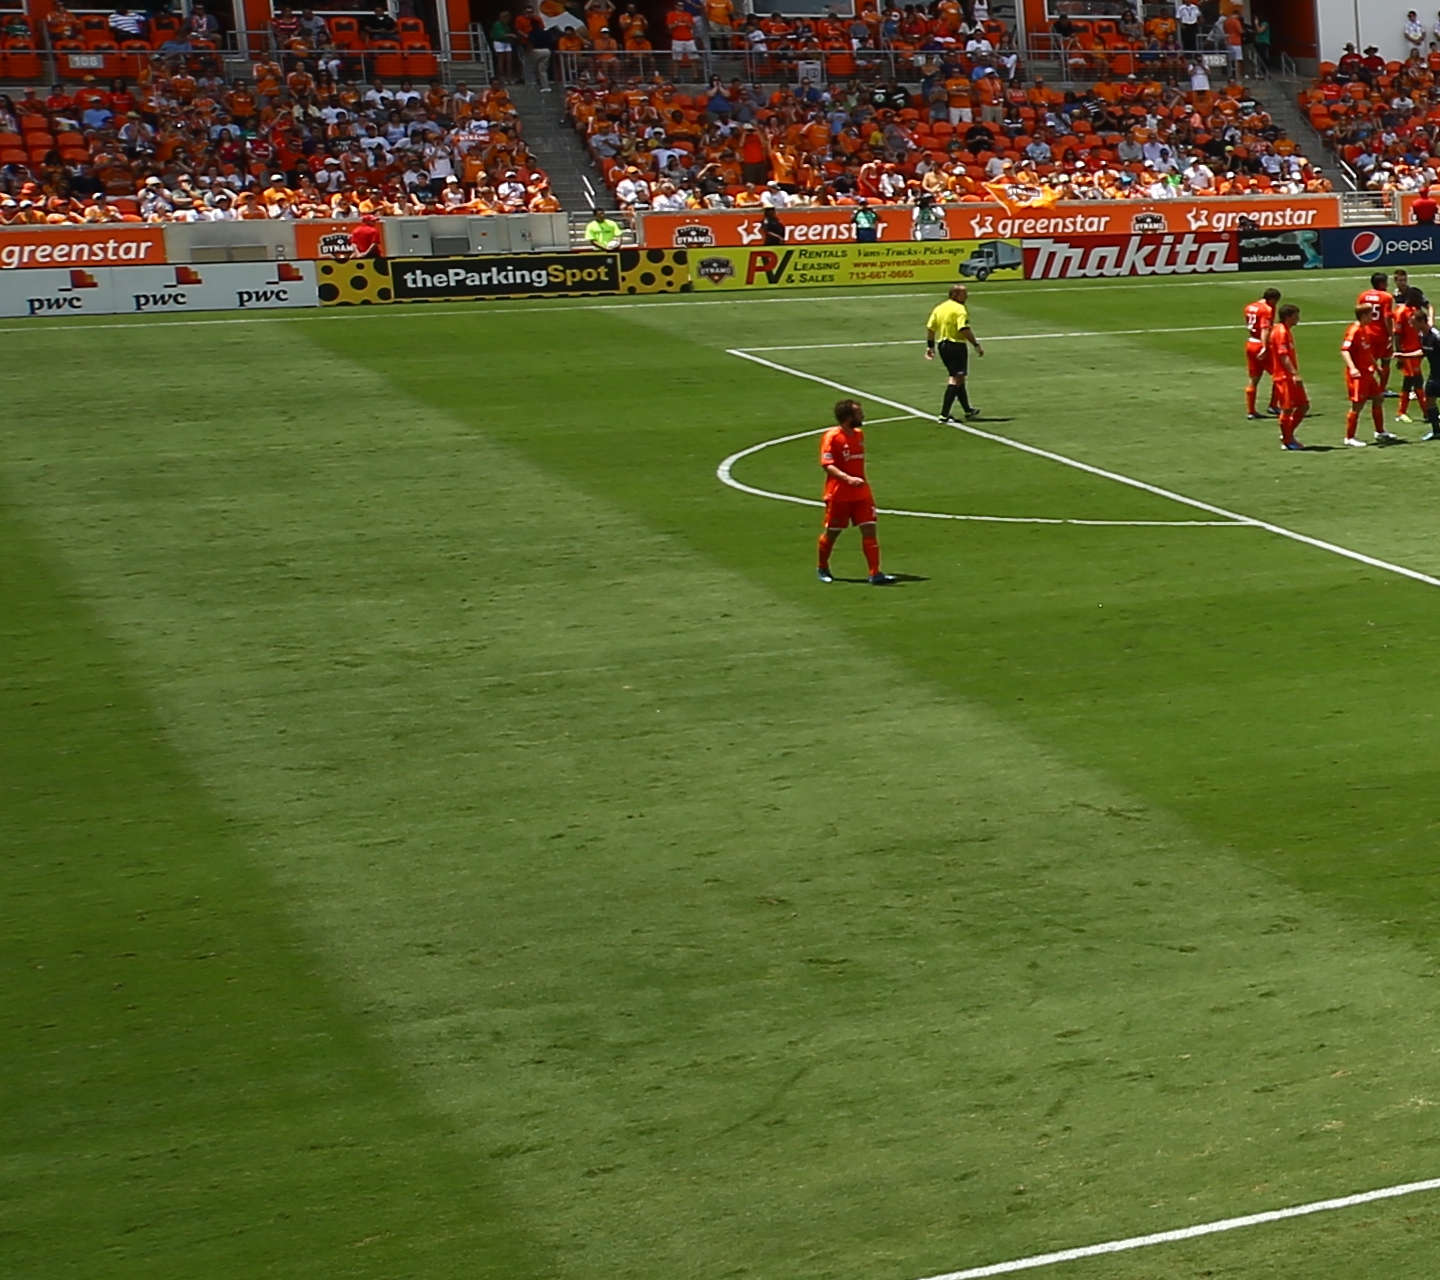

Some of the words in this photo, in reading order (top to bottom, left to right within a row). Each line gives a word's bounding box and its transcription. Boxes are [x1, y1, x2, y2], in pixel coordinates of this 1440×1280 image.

[998, 214, 1109, 238] greenstar
[1, 239, 152, 268] greenstar
[322, 244, 354, 254] DYNAM
[1386, 237, 1433, 255] pepsi
[745, 250, 795, 285] PV
[853, 258, 950, 269] www.pvrentals.com
[1242, 253, 1301, 264] makitatools.com
[404, 265, 609, 289] theParkingSpot
[786, 275, 795, 284] &
[27, 294, 84, 315] pwc
[133, 292, 187, 310] pwc
[236, 288, 289, 307] pwc
